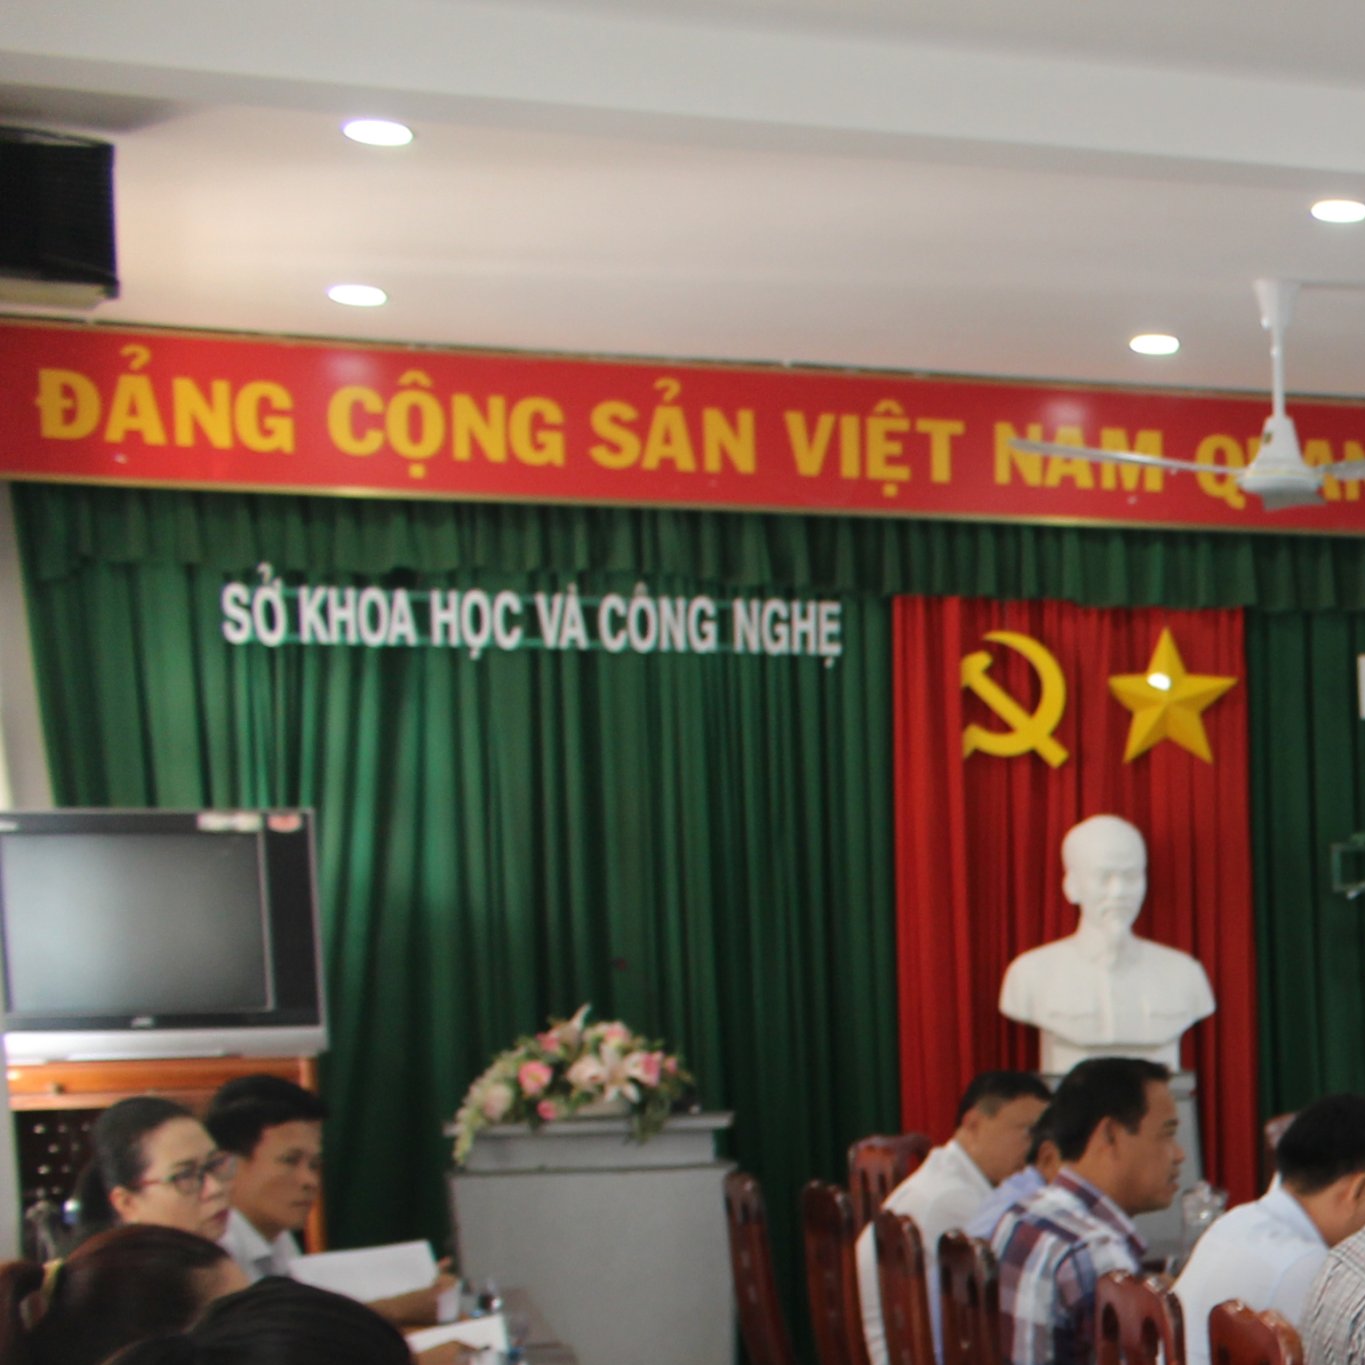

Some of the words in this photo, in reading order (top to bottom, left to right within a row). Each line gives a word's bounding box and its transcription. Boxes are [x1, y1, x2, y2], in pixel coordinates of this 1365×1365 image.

[35, 345, 295, 454] ĐẢNG
[327, 370, 564, 478] CỘNG
[590, 378, 756, 475] SẢN
[784, 400, 965, 497] VIỆT
[994, 422, 1162, 492] NAM
[222, 561, 287, 647] SỞ
[299, 586, 418, 647] KHOA
[430, 589, 523, 661] HỌC
[534, 582, 588, 650] VÀ
[599, 581, 717, 654] CÔNG
